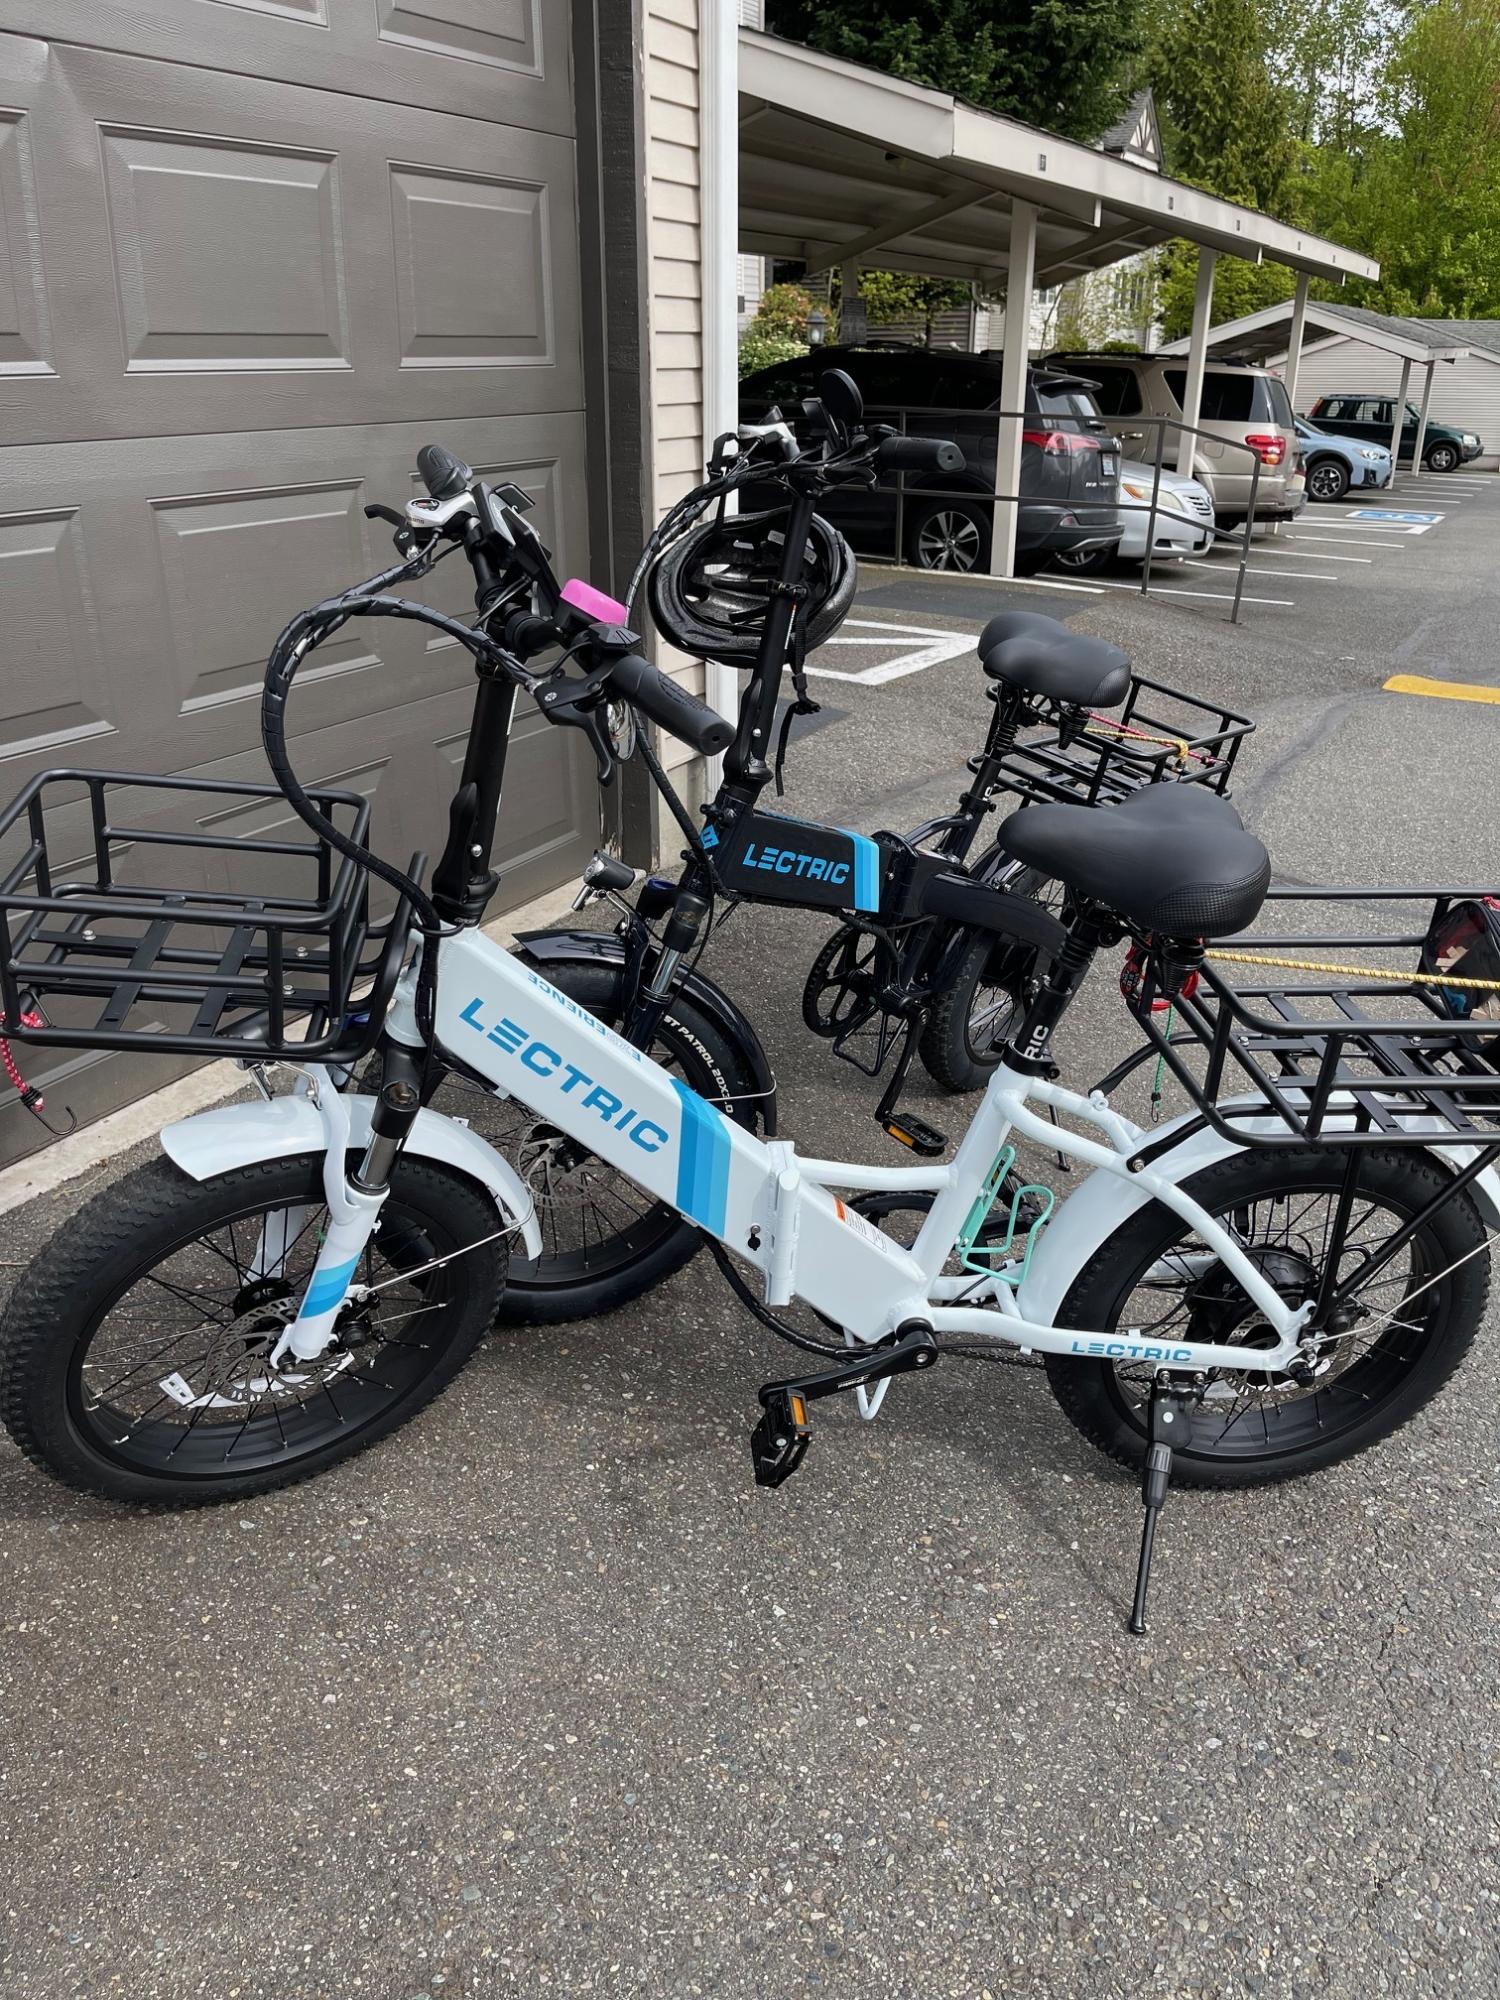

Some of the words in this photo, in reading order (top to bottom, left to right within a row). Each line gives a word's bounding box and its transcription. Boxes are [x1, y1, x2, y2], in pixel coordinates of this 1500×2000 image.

[742, 843, 850, 885] LECTRIC
[527, 970, 642, 1063] EERIENCE
[661, 1012, 681, 1028] ST
[678, 1026, 715, 1068] PATROL
[459, 997, 669, 1153] LECTRIC
[1071, 1341, 1193, 1362] LECTRIC
